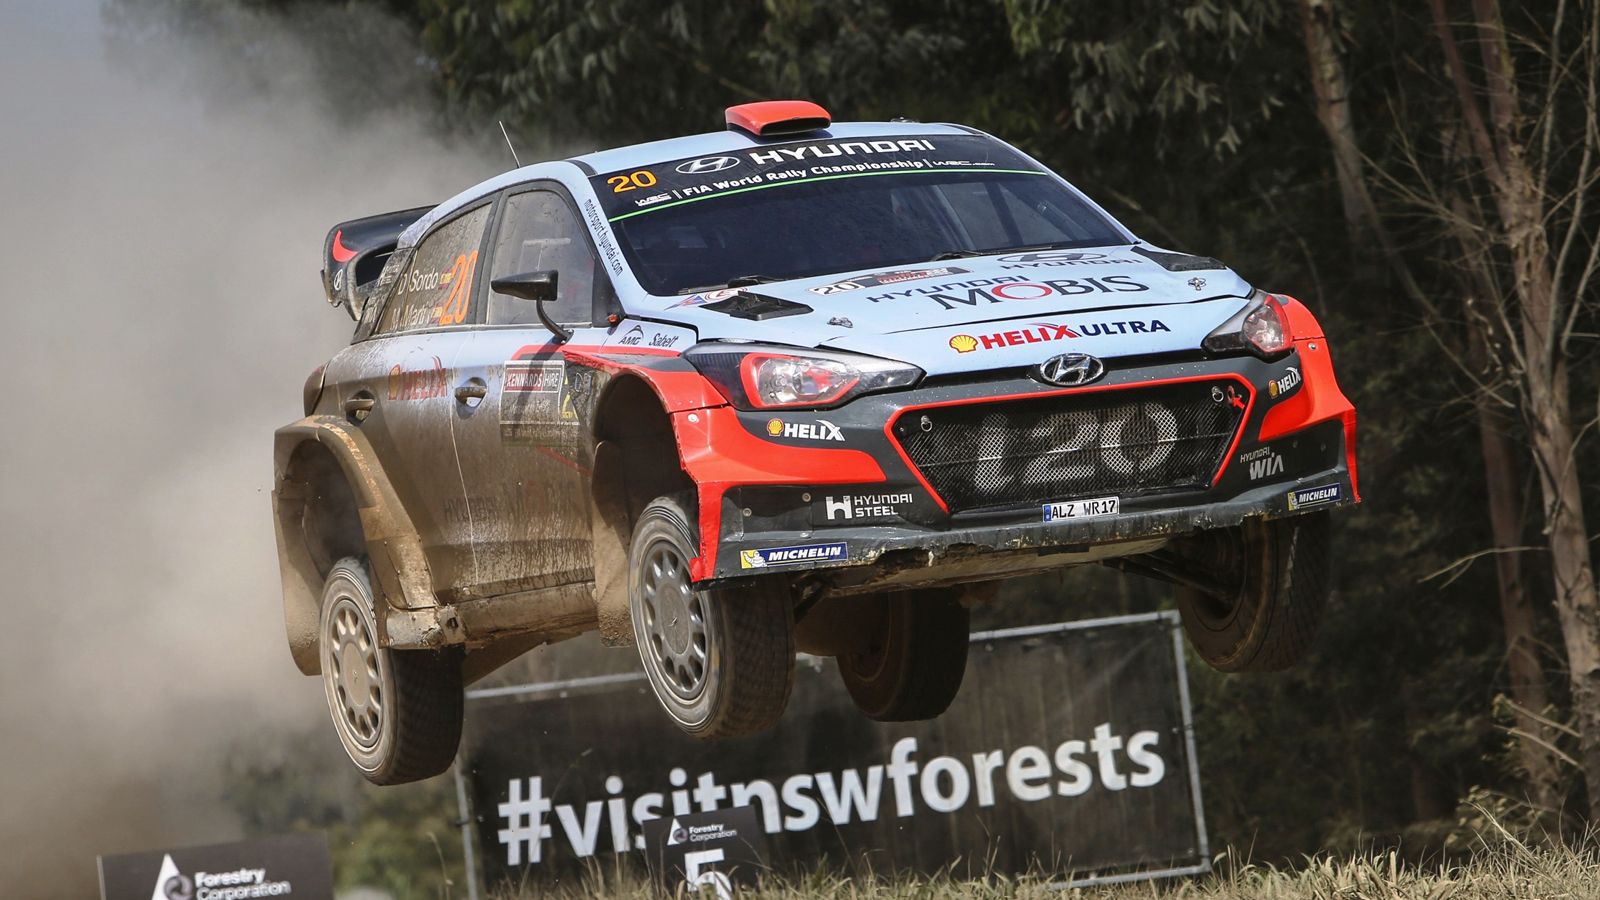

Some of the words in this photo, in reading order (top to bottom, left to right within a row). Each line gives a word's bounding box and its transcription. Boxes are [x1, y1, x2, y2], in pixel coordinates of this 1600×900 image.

[749, 139, 936, 165] HYUNDAI
[607, 170, 657, 193] 20
[682, 185, 713, 197] FIA
[713, 174, 763, 190] World
[765, 168, 807, 181] Rally
[810, 159, 923, 175] Championship
[584, 198, 624, 277] motorsport.hyundai.com
[1000, 259, 1143, 270] HYUNDAI
[409, 267, 439, 293] Sordo
[439, 250, 479, 326] 20
[814, 280, 859, 295] 20
[866, 275, 1031, 303] HYUNDAI
[927, 275, 1150, 310] MOBIS
[649, 332, 679, 348] Sabelt
[978, 322, 1083, 350] HELIX
[1079, 319, 1172, 337] ULTRA
[506, 373, 543, 387] KENNARDS
[1277, 366, 1302, 395] HELIX
[784, 419, 846, 442] HELIX
[1240, 446, 1271, 464] HYUNDAI
[854, 493, 913, 506] HYUNDAI
[1298, 487, 1338, 503] MICHELIN
[856, 506, 899, 517] STEEL
[1051, 504, 1076, 518] ALZ
[768, 546, 842, 562] MICHELIN
[689, 823, 725, 834] Forestry
[690, 829, 737, 842] Corporation
[194, 868, 266, 888] Forestry
[685, 848, 733, 900] 5
[196, 881, 292, 900] Corporation
